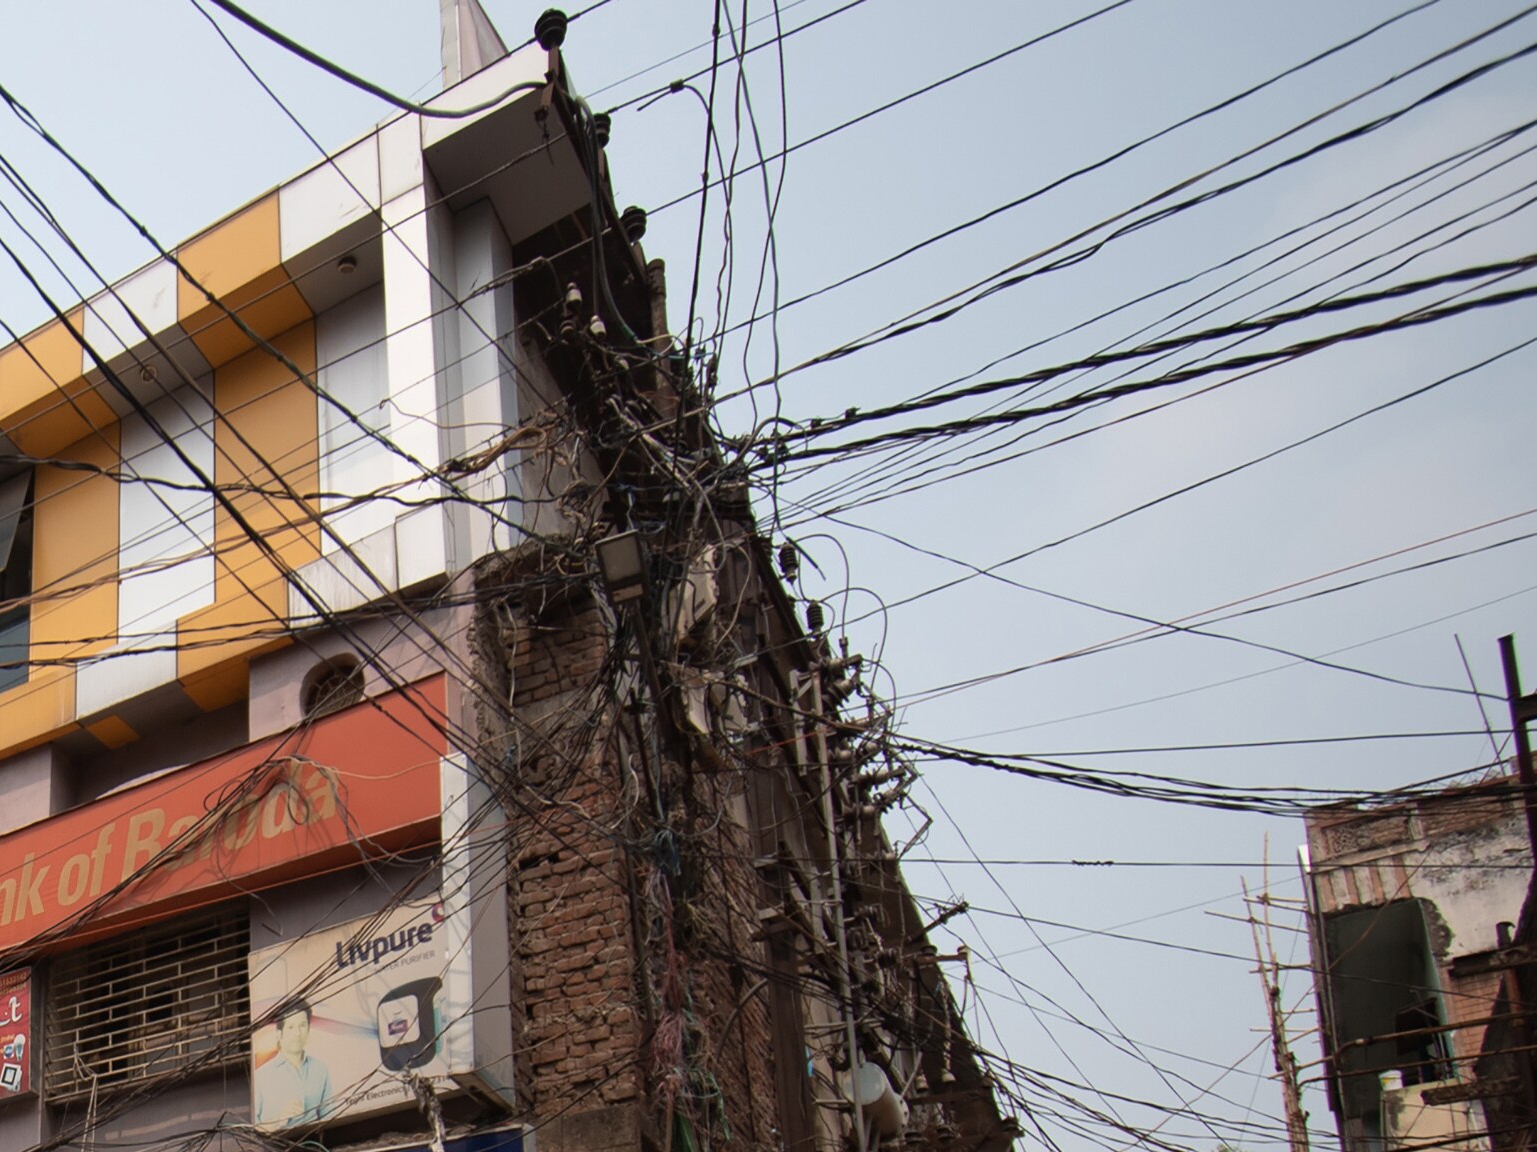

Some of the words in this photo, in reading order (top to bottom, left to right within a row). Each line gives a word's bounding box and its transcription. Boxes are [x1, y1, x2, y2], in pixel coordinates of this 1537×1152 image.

[57, 822, 117, 905] of
[335, 922, 433, 970] Livpure
[401, 950, 436, 966] PURIFIER
